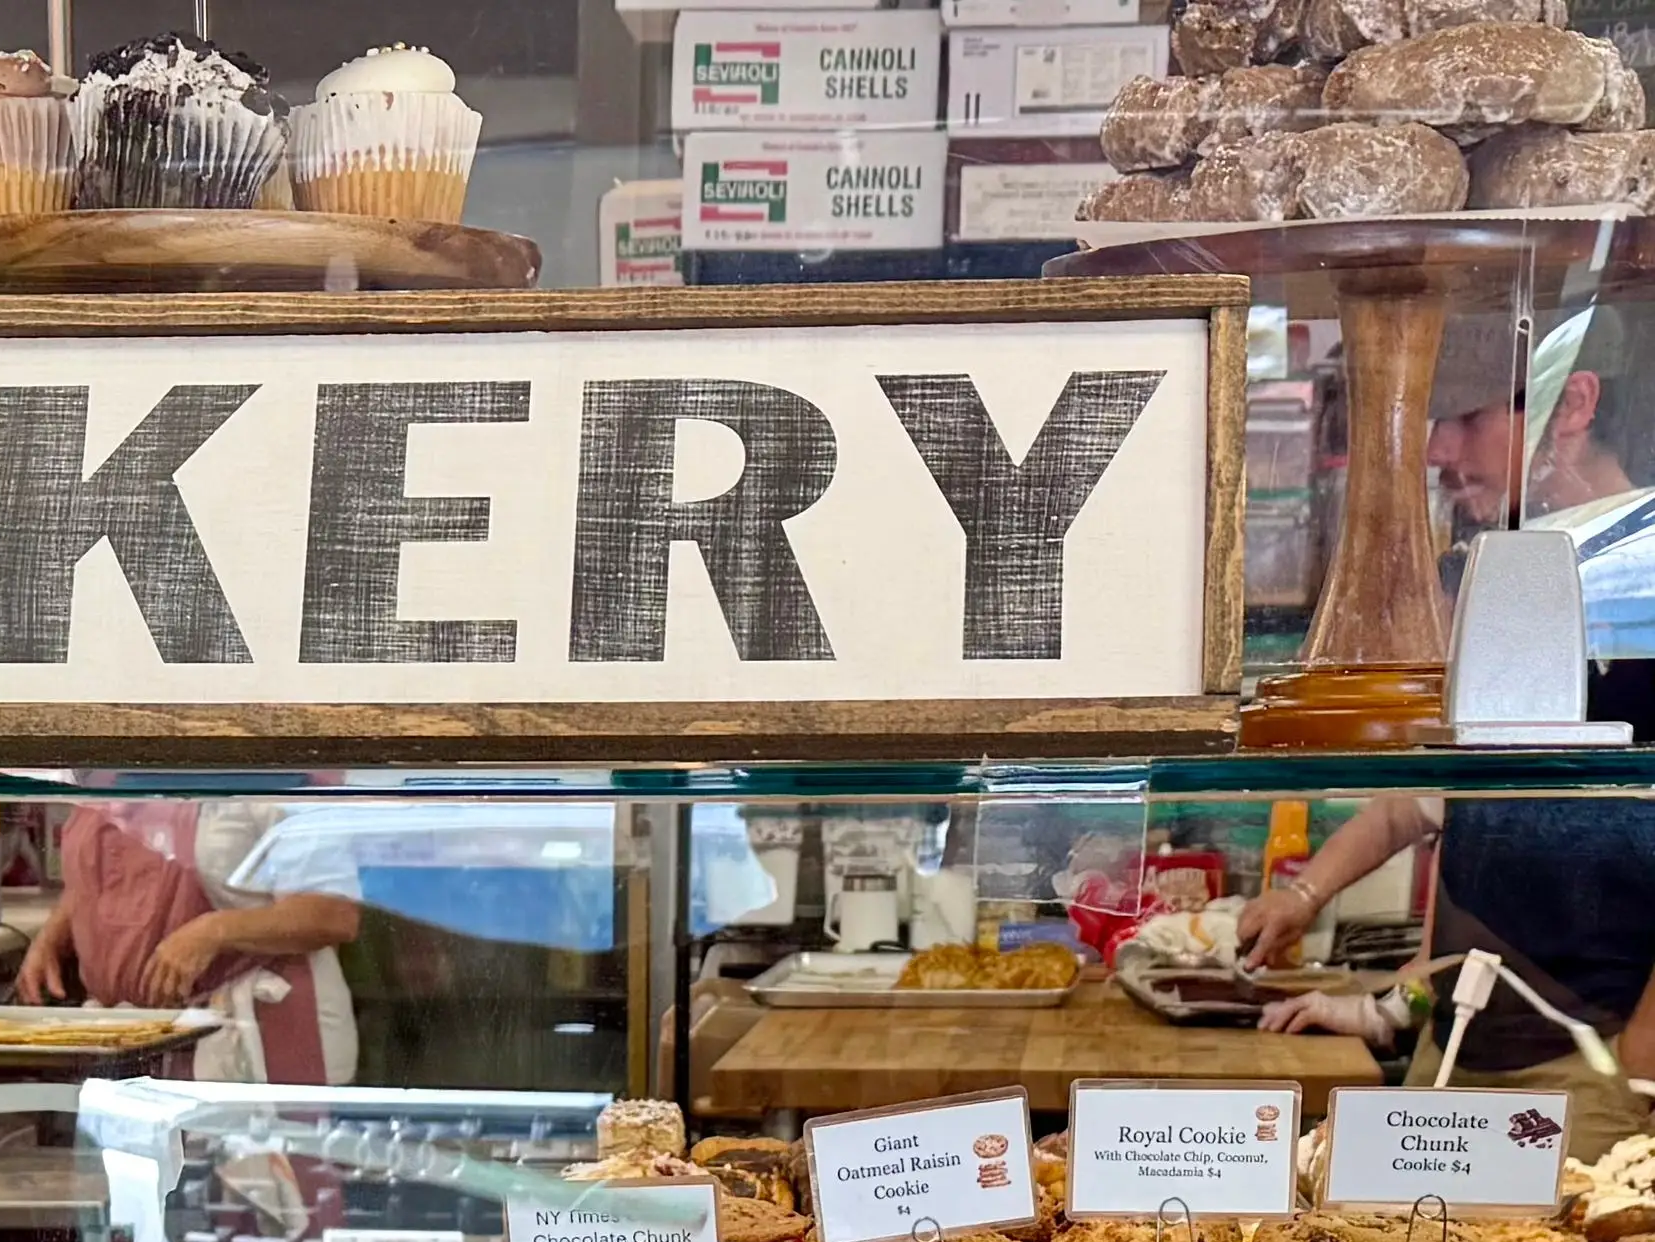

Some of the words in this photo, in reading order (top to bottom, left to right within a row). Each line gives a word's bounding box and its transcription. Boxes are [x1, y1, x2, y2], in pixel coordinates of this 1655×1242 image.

[820, 47, 915, 71] CANNOLI
[825, 76, 908, 99] SHELLS
[827, 166, 921, 190] CANNOLI
[832, 194, 914, 217] SHELLS
[1387, 1111, 1489, 1130] Chocolate
[874, 1135, 919, 1153] Giant
[1118, 1126, 1172, 1147] Royal
[1179, 1126, 1246, 1144] Cookie
[1400, 1134, 1469, 1152] Chunk
[1094, 1150, 1122, 1161] With
[1125, 1150, 1181, 1162] Chocolate
[1183, 1151, 1214, 1164] Chip,
[1217, 1152, 1268, 1164] Coconut,
[837, 1158, 905, 1182] Oatmeal
[910, 1153, 961, 1172] Raisin
[1138, 1166, 1203, 1177] Macadamia
[1207, 1167, 1221, 1178] $4
[1392, 1158, 1446, 1172] Cookie
[1451, 1159, 1471, 1175] $4
[874, 1181, 929, 1199] Cookie
[536, 1211, 561, 1225] NY
